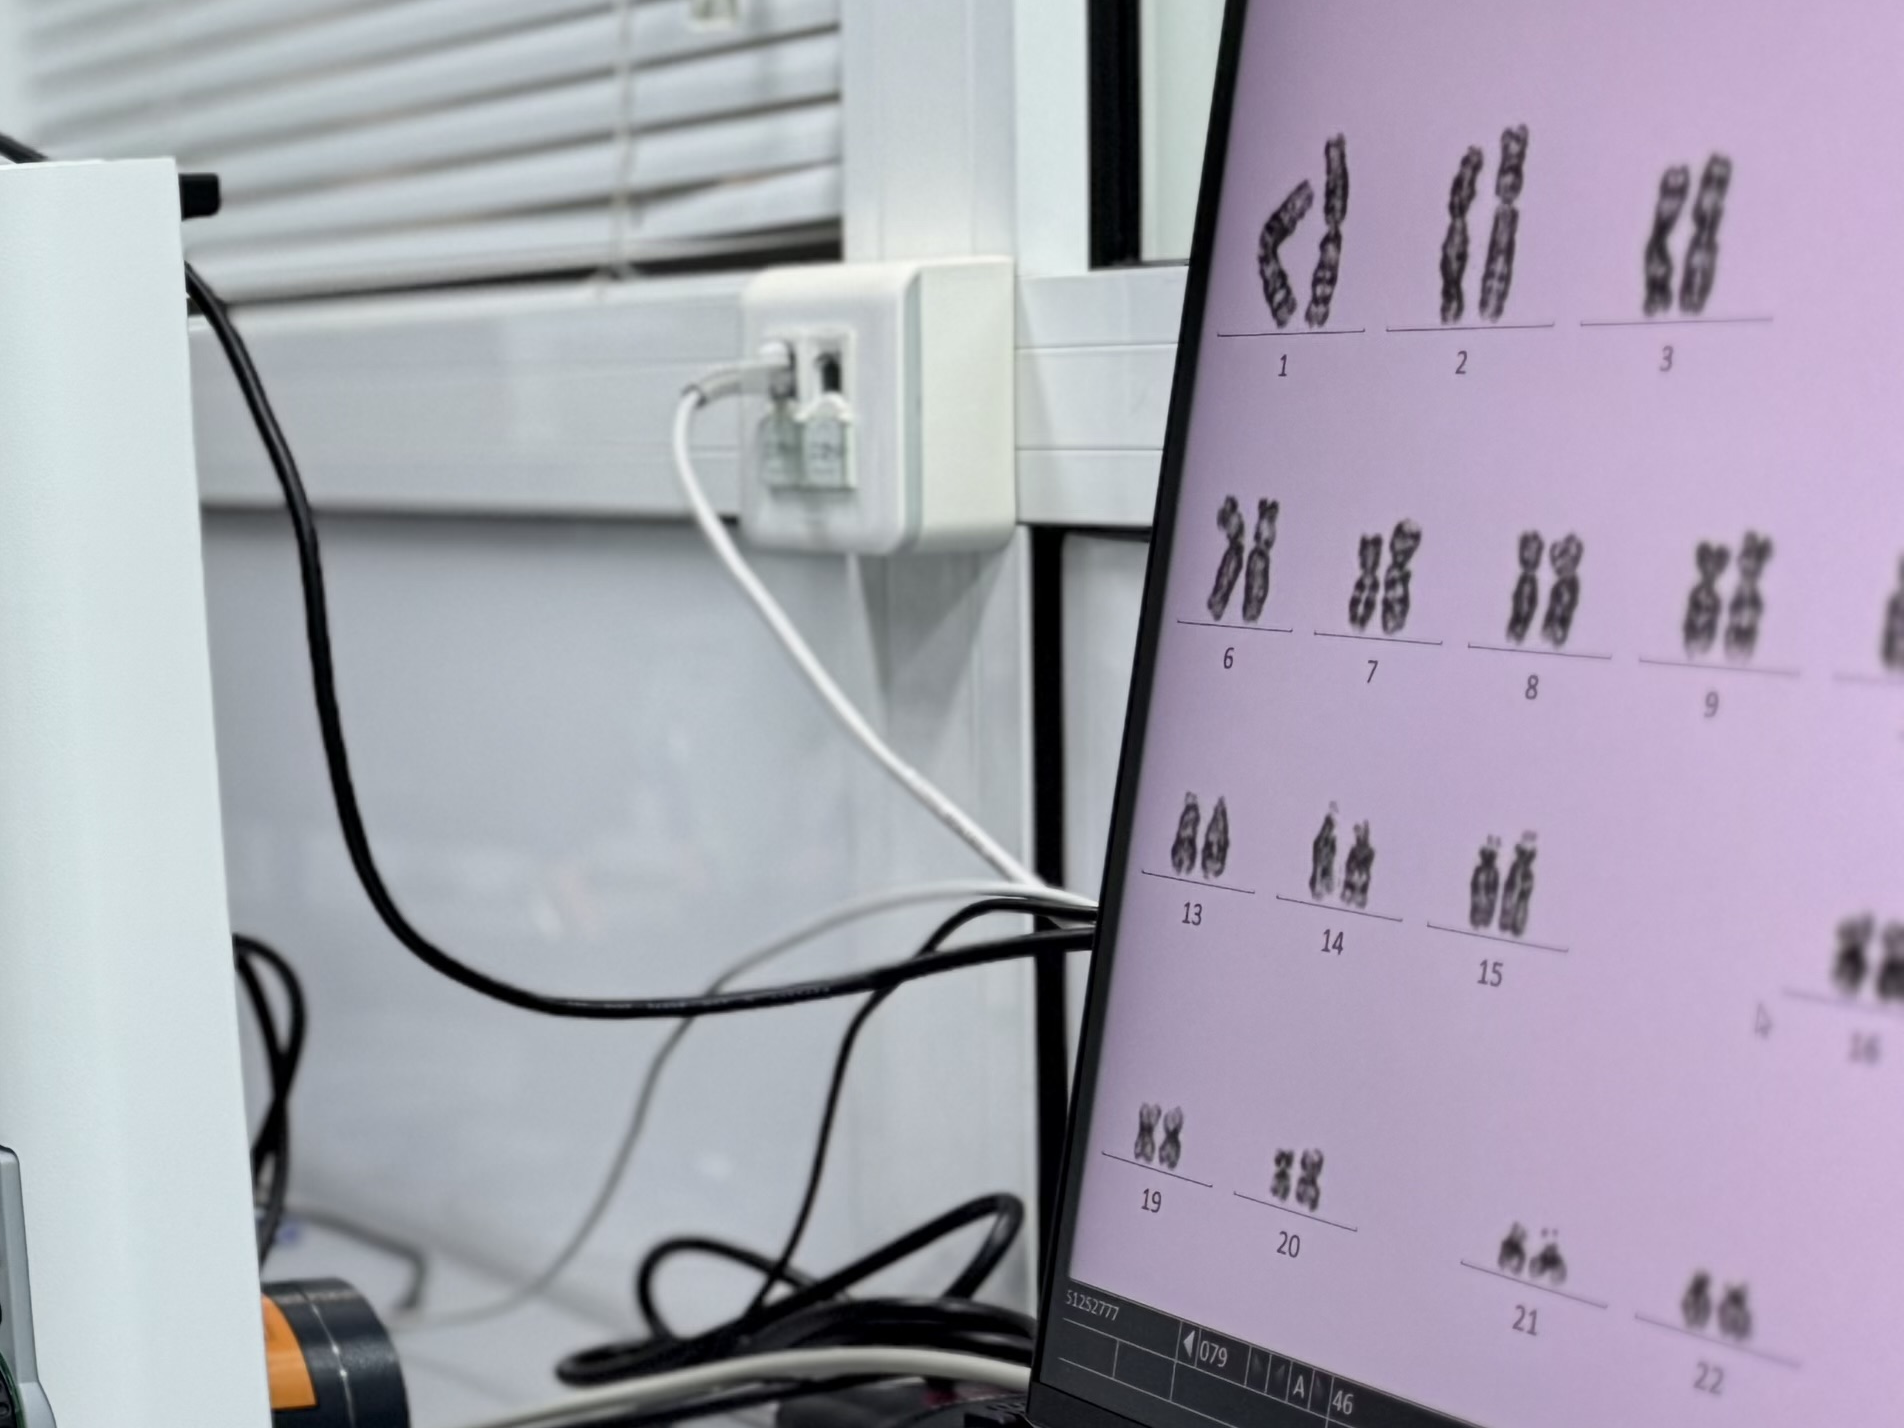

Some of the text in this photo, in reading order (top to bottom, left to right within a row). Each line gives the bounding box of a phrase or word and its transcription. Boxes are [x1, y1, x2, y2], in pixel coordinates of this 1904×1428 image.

[1277, 354, 1288, 376] 1
[1455, 350, 1468, 375] 2
[1659, 345, 1674, 372] 3
[1222, 647, 1234, 671] 6
[1365, 660, 1378, 683] 7
[1524, 675, 1539, 700] 8
[1703, 691, 1720, 718] 9
[1181, 901, 1203, 926] 13
[1320, 928, 1345, 956] 14
[1477, 959, 1504, 989] 15
[1141, 1188, 1162, 1214] 19
[1276, 1230, 1301, 1259] 20
[1065, 1289, 1120, 1321] 51252777
[1511, 1304, 1539, 1336] 21
[1199, 1340, 1228, 1367] 079
[1293, 1375, 1305, 1398] A
[1693, 1362, 1724, 1396] 22
[1332, 1390, 1354, 1415] 46
